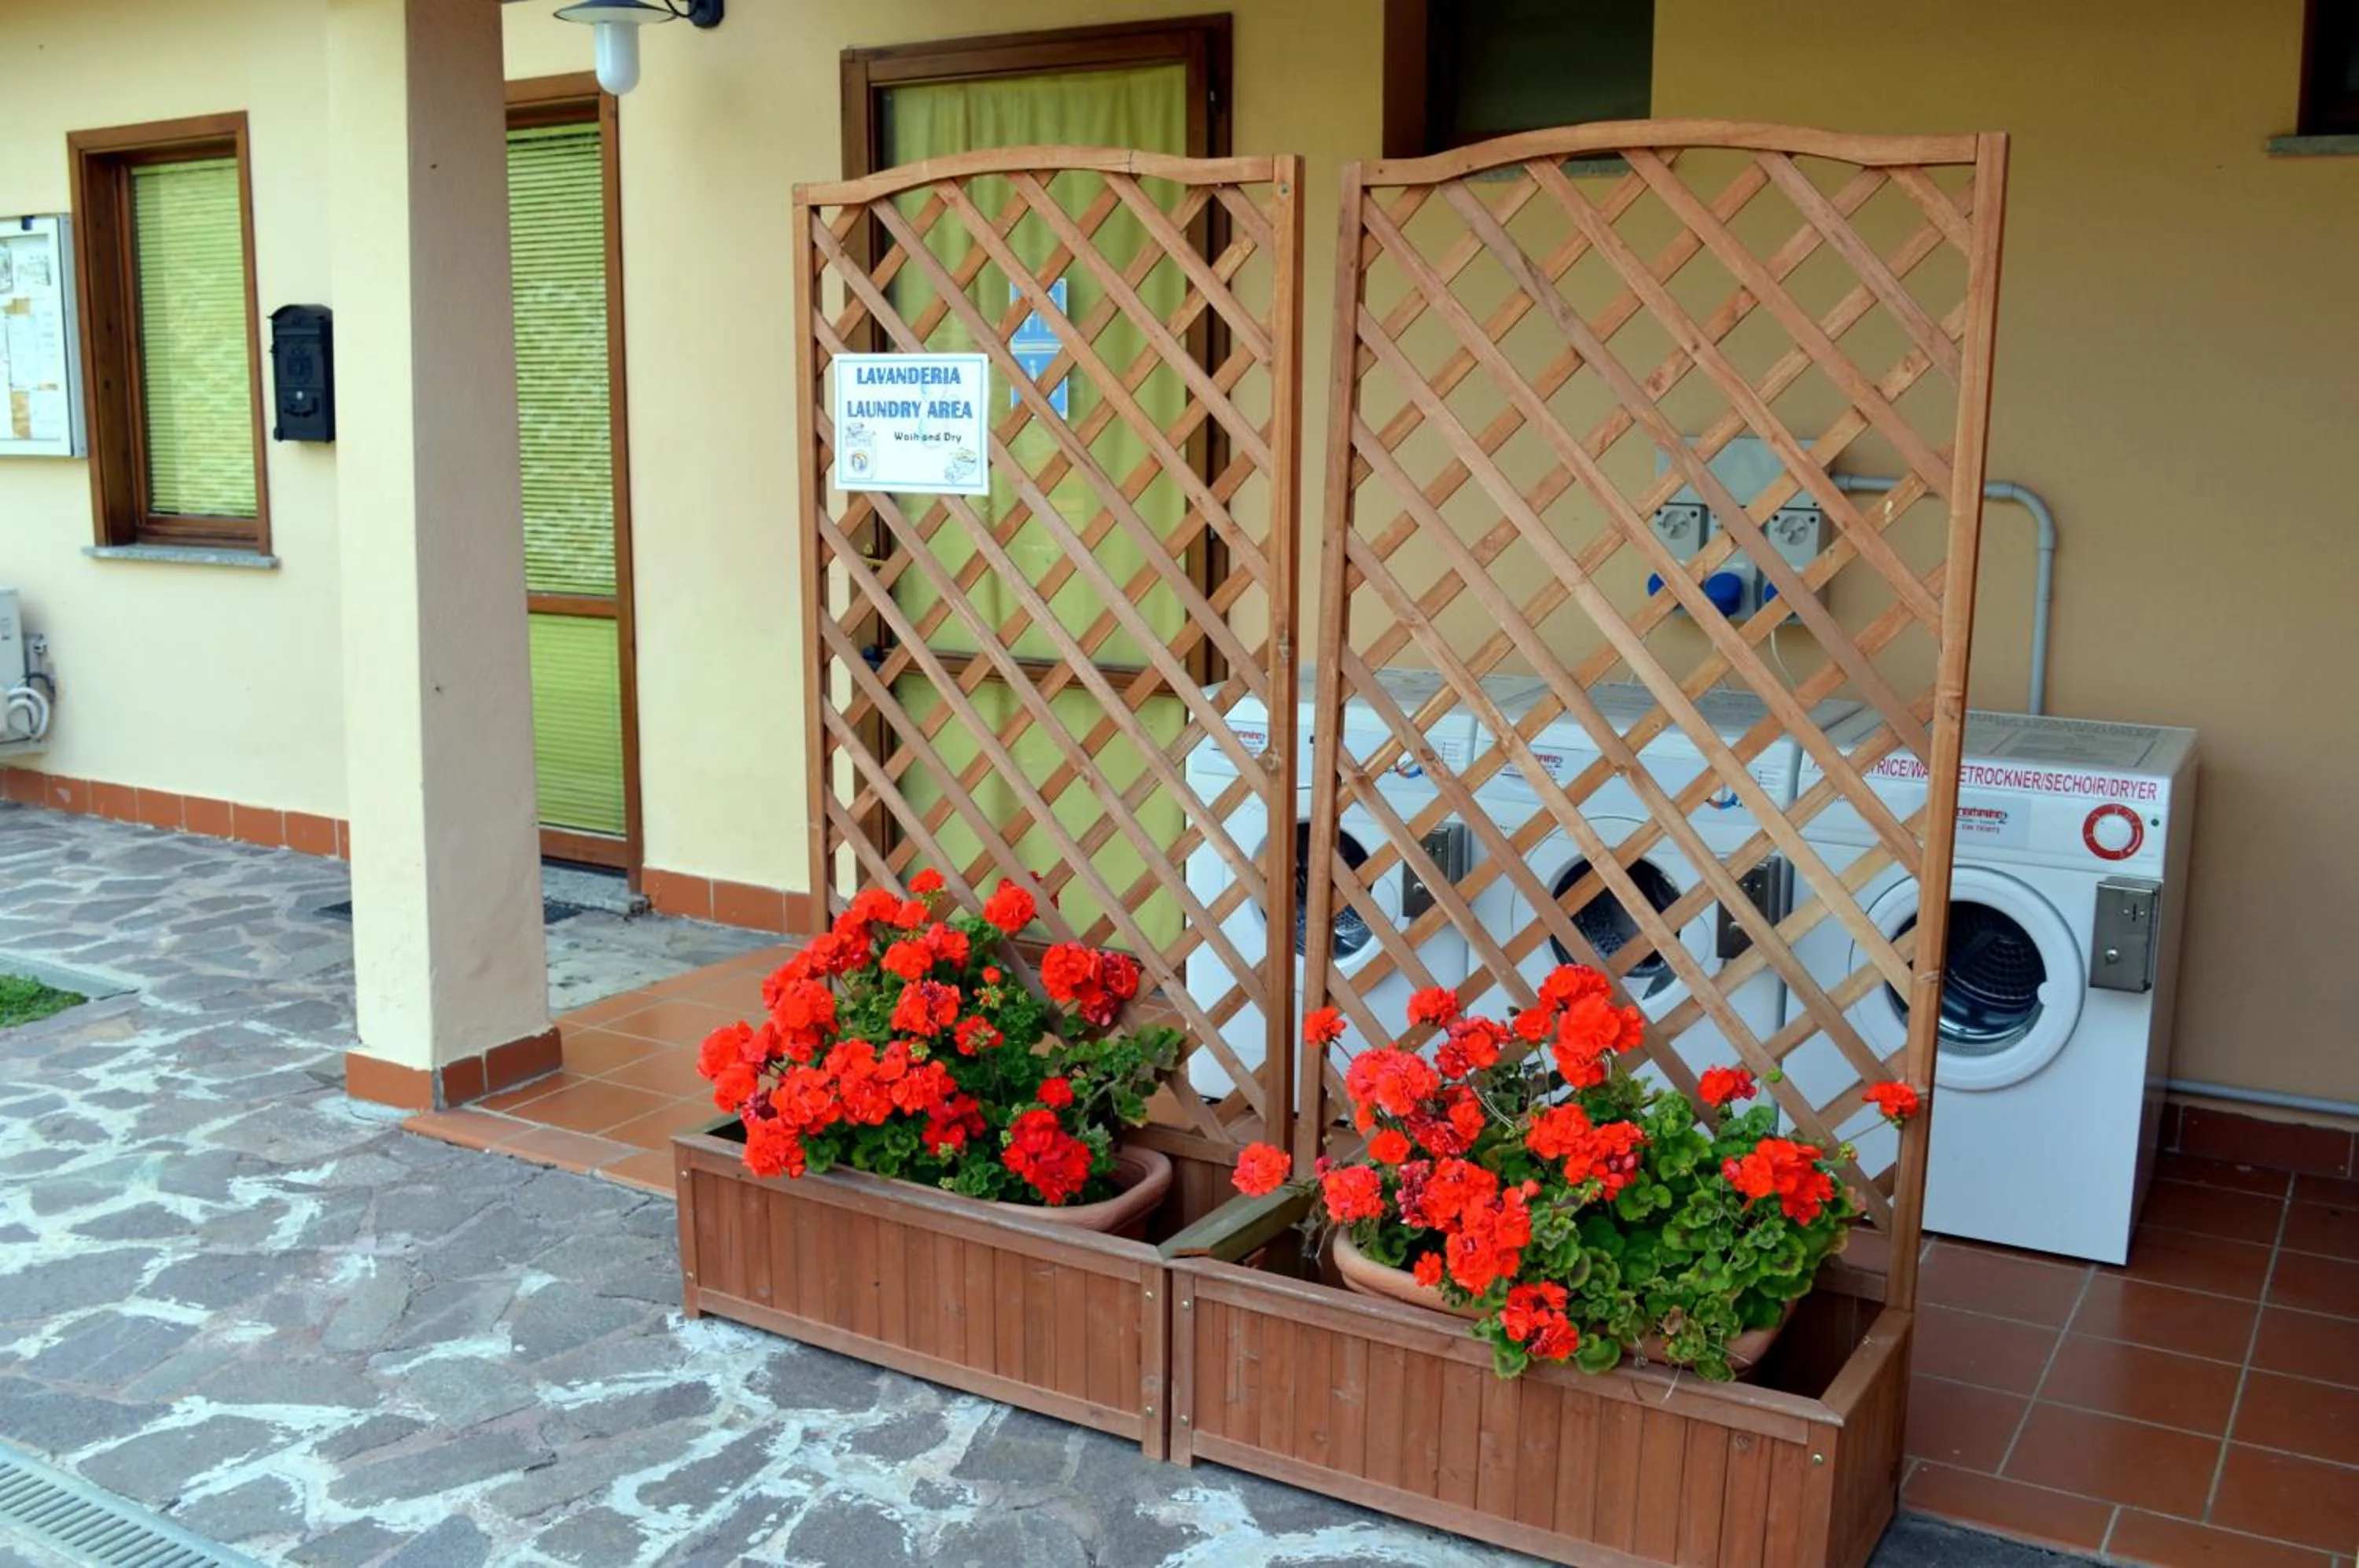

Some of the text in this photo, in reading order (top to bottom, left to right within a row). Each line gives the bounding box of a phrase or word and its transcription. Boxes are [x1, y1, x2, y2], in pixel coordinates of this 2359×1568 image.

[856, 366, 962, 385] LAVANDERIA
[846, 399, 973, 419] LAUNDRY AREA
[944, 431, 962, 445] Dry
